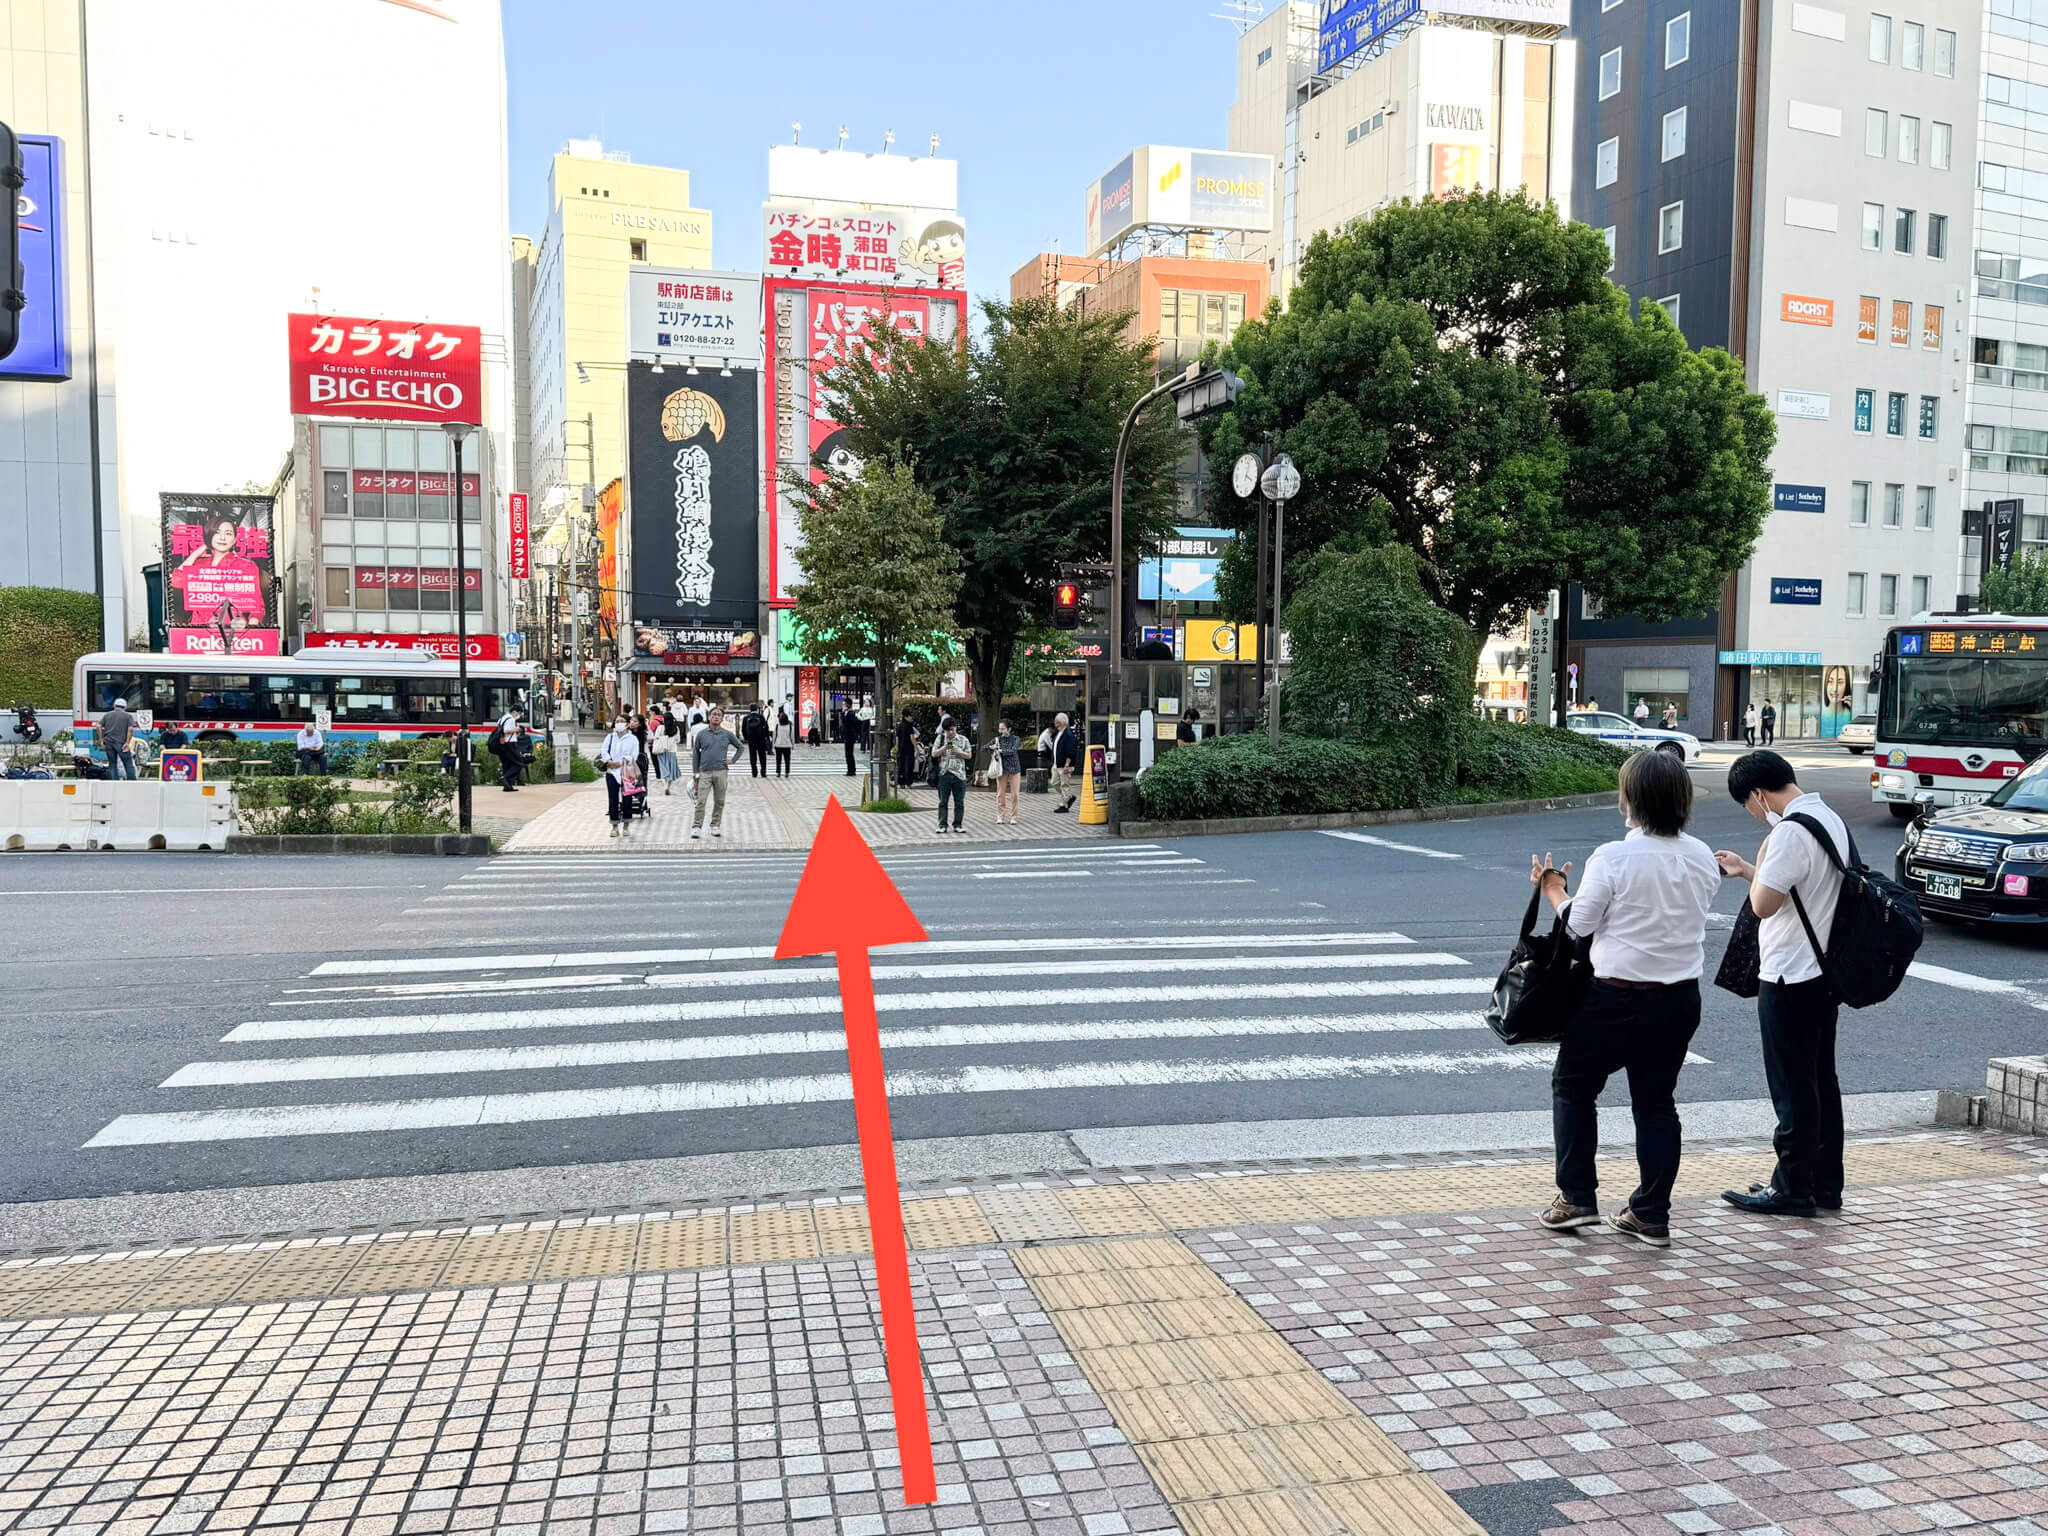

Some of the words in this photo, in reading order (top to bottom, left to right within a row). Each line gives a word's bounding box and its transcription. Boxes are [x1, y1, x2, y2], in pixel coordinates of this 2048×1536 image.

[1426, 103, 1484, 131] KAWATA
[1196, 177, 1264, 198] PROMISE
[1102, 179, 1131, 216] PROMISE
[769, 229, 842, 269] 金時
[853, 235, 887, 254] 蒲田
[845, 254, 896, 273] 東口店
[658, 282, 733, 302] 駅前店舗は
[1788, 301, 1828, 316] ADCAST
[658, 311, 734, 330] エリアクエスト
[777, 302, 793, 349] SLOT
[813, 302, 924, 337] パチンコ
[673, 334, 735, 345] 0120-88-27-22
[1858, 320, 1875, 335] アド
[1891, 326, 1908, 338] キャ
[1922, 329, 1938, 343] スト
[309, 325, 462, 361] カラオケ
[323, 364, 366, 375] Karaoke
[370, 366, 447, 379] Entertainment
[309, 374, 369, 403] BIG
[376, 380, 463, 410] ECHO
[1857, 392, 1869, 430] 内科
[360, 476, 413, 488] カラオケ
[419, 479, 441, 490] BIG
[442, 480, 474, 492] ECO
[513, 497, 521, 512] BIG
[513, 512, 521, 533] ECHO
[514, 537, 525, 576] カラオケ
[361, 572, 415, 584] カラオケ
[422, 575, 442, 586] BIG
[444, 575, 476, 587] ECO
[1960, 635, 2036, 650] 蒲田駅
[1934, 882, 1960, 897] 70-08
